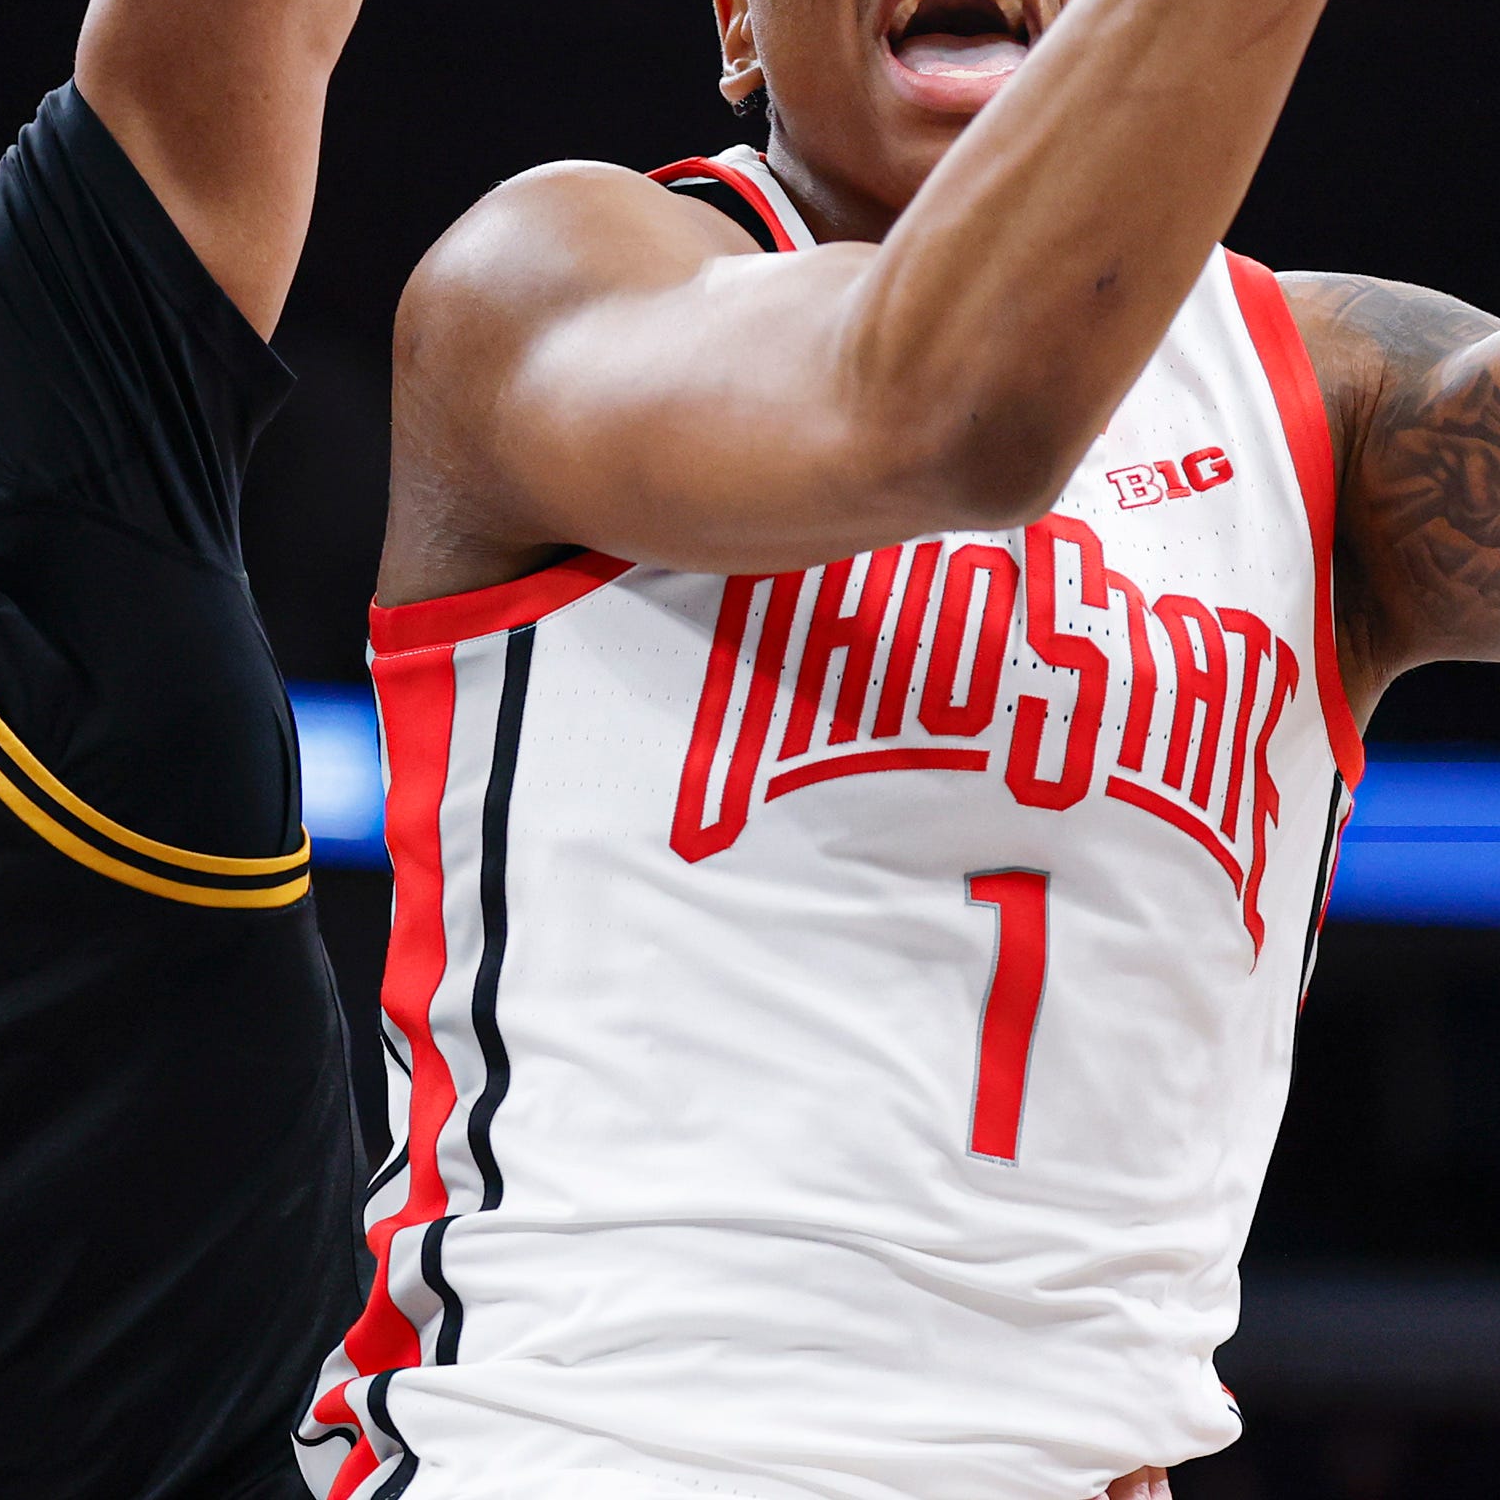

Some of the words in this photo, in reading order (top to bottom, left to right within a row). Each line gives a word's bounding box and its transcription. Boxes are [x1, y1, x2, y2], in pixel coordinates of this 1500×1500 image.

[669, 540, 1020, 864] OHIO
[1004, 512, 1299, 975] STATE
[964, 866, 1051, 1167] 1
